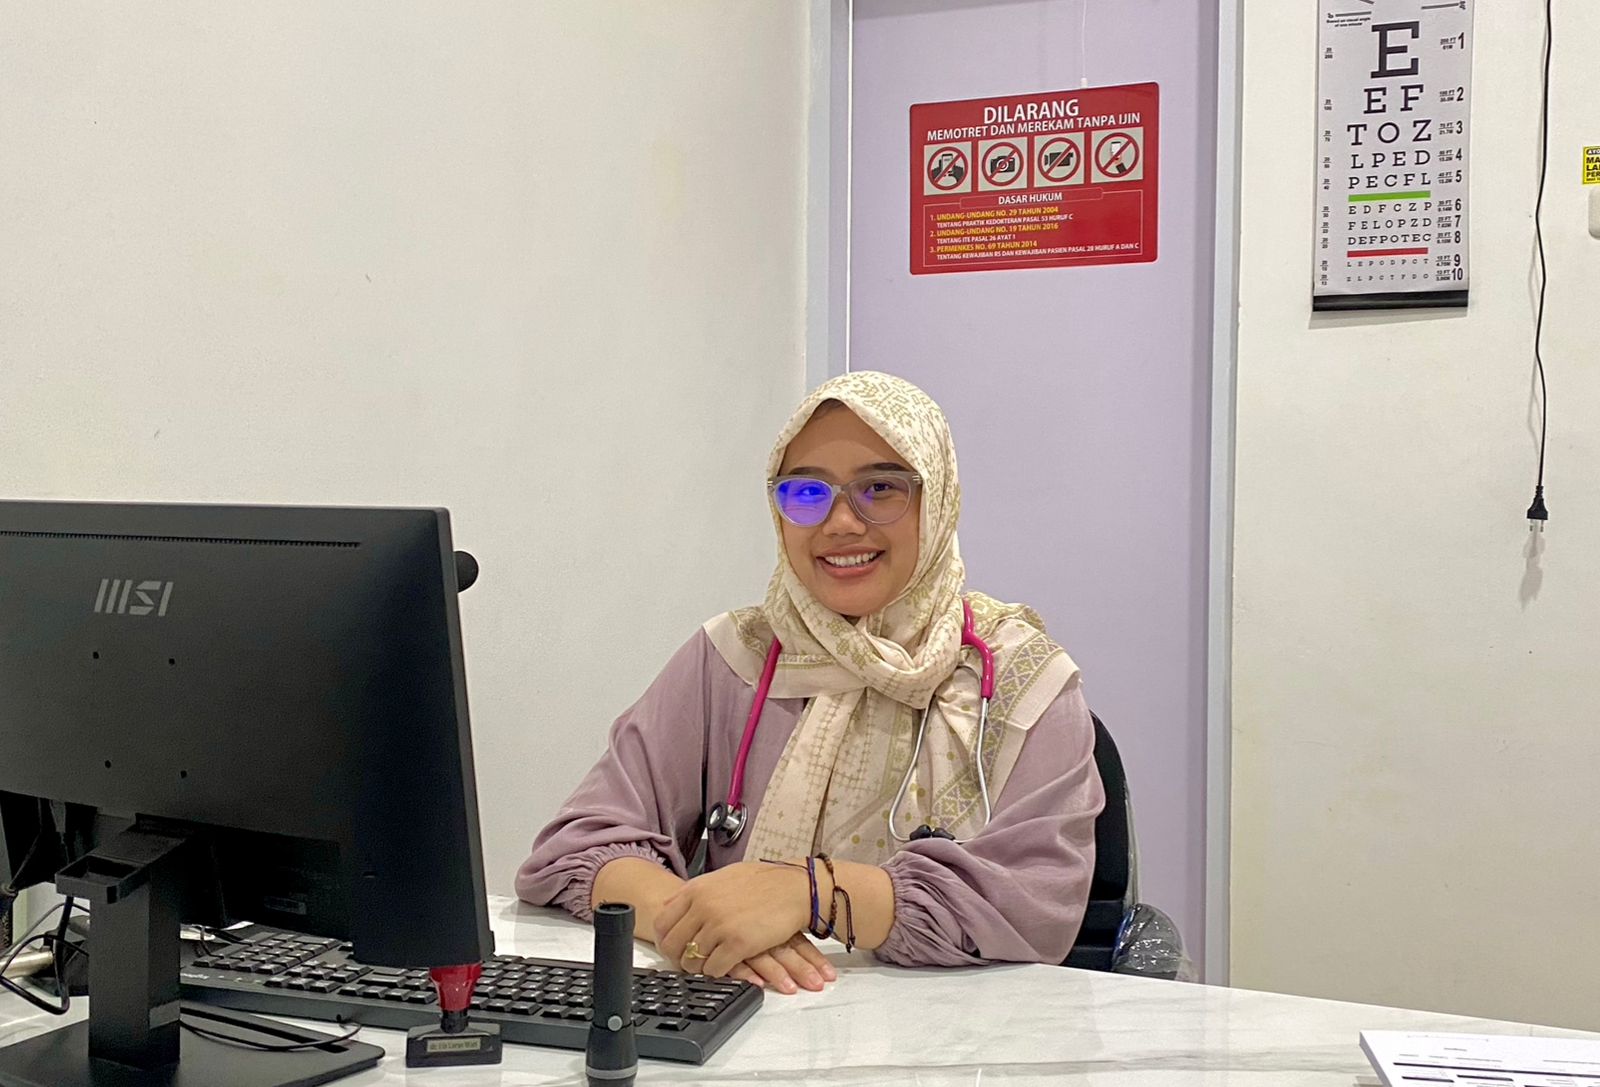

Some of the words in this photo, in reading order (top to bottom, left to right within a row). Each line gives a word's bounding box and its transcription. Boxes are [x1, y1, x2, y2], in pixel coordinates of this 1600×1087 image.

[1458, 32, 1465, 49] 1
[1371, 21, 1420, 78] E
[1456, 86, 1464, 101] 2
[984, 99, 1079, 124] DILARANG
[927, 125, 988, 141] MEMOTRET
[990, 124, 1015, 136] DAN
[1017, 118, 1074, 133] MEREKAM
[1077, 114, 1116, 128] TANPA
[1118, 112, 1140, 125] IJIN
[1456, 120, 1463, 134] 3
[1455, 147, 1462, 161] 4
[1455, 169, 1462, 183] 5
[998, 194, 1028, 205] DASAR
[1029, 192, 1063, 203] HUKUM
[1454, 198, 1462, 212] 6
[936, 210, 995, 221] UNDANG-UNDANG
[1008, 208, 1018, 216] 29
[1018, 207, 1041, 215] TAHUN
[1042, 206, 1059, 214] 2004
[937, 221, 962, 229] TENTANG
[962, 219, 985, 228] PRAKTIK
[1454, 214, 1462, 228] 7
[936, 227, 995, 237] UNDANG-UNDANG
[1042, 222, 1059, 230] 2016
[937, 237, 962, 245] TENTANG
[1454, 230, 1461, 244] 8
[936, 243, 974, 253] PERMENKES
[975, 242, 987, 250] NO.
[996, 241, 1020, 249] TAHUN
[1021, 240, 1038, 248] 2014
[1015, 248, 1047, 256] KEWAJIBAN
[1453, 253, 1461, 267] 9
[1451, 267, 1464, 281] 10
